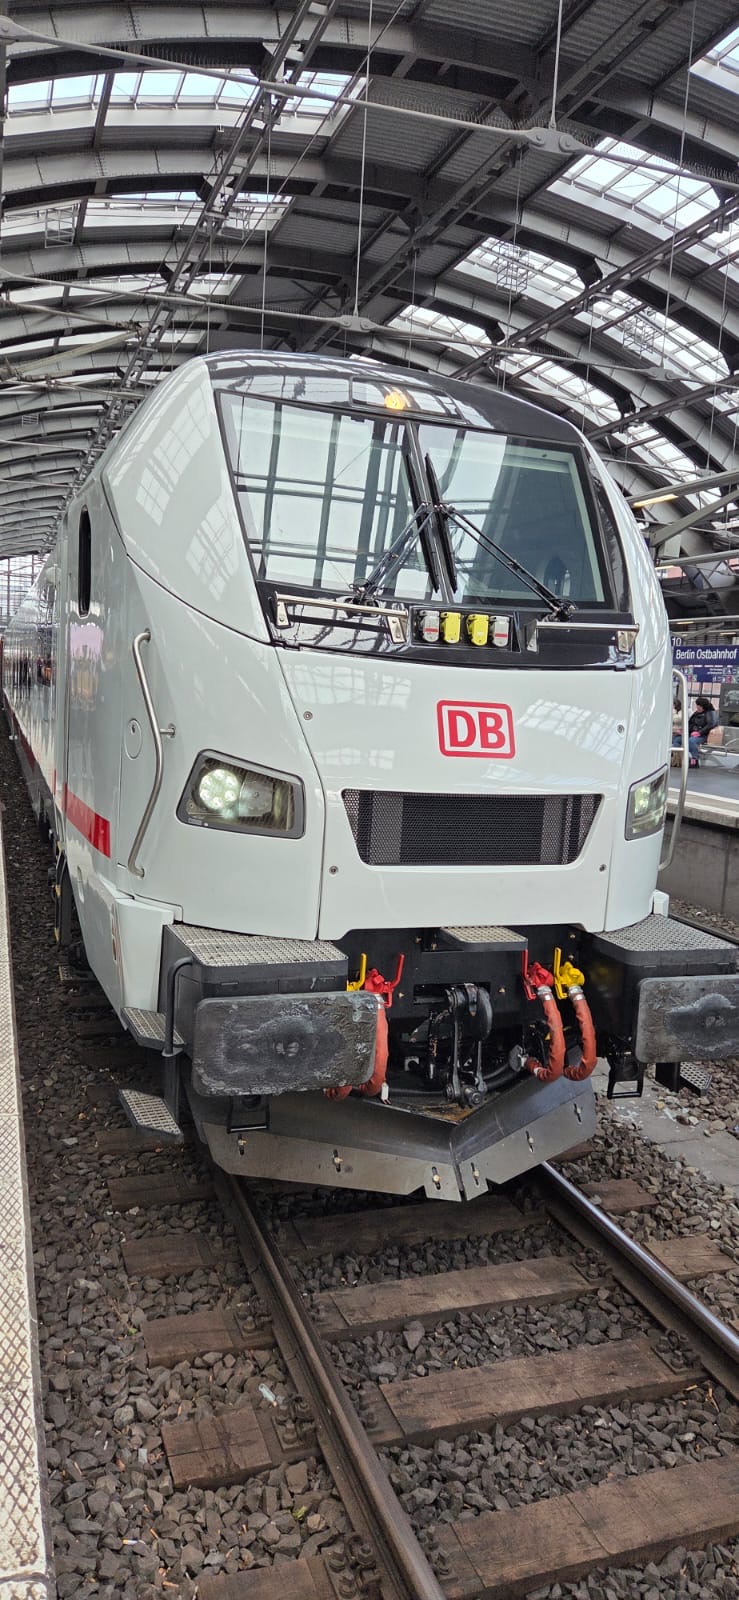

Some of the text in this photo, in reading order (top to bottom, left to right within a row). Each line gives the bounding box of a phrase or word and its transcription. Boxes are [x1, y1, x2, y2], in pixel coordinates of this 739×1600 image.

[672, 638, 682, 646] 10
[676, 648, 738, 660] Berlin Ostbahnhof
[447, 710, 506, 749] DB
